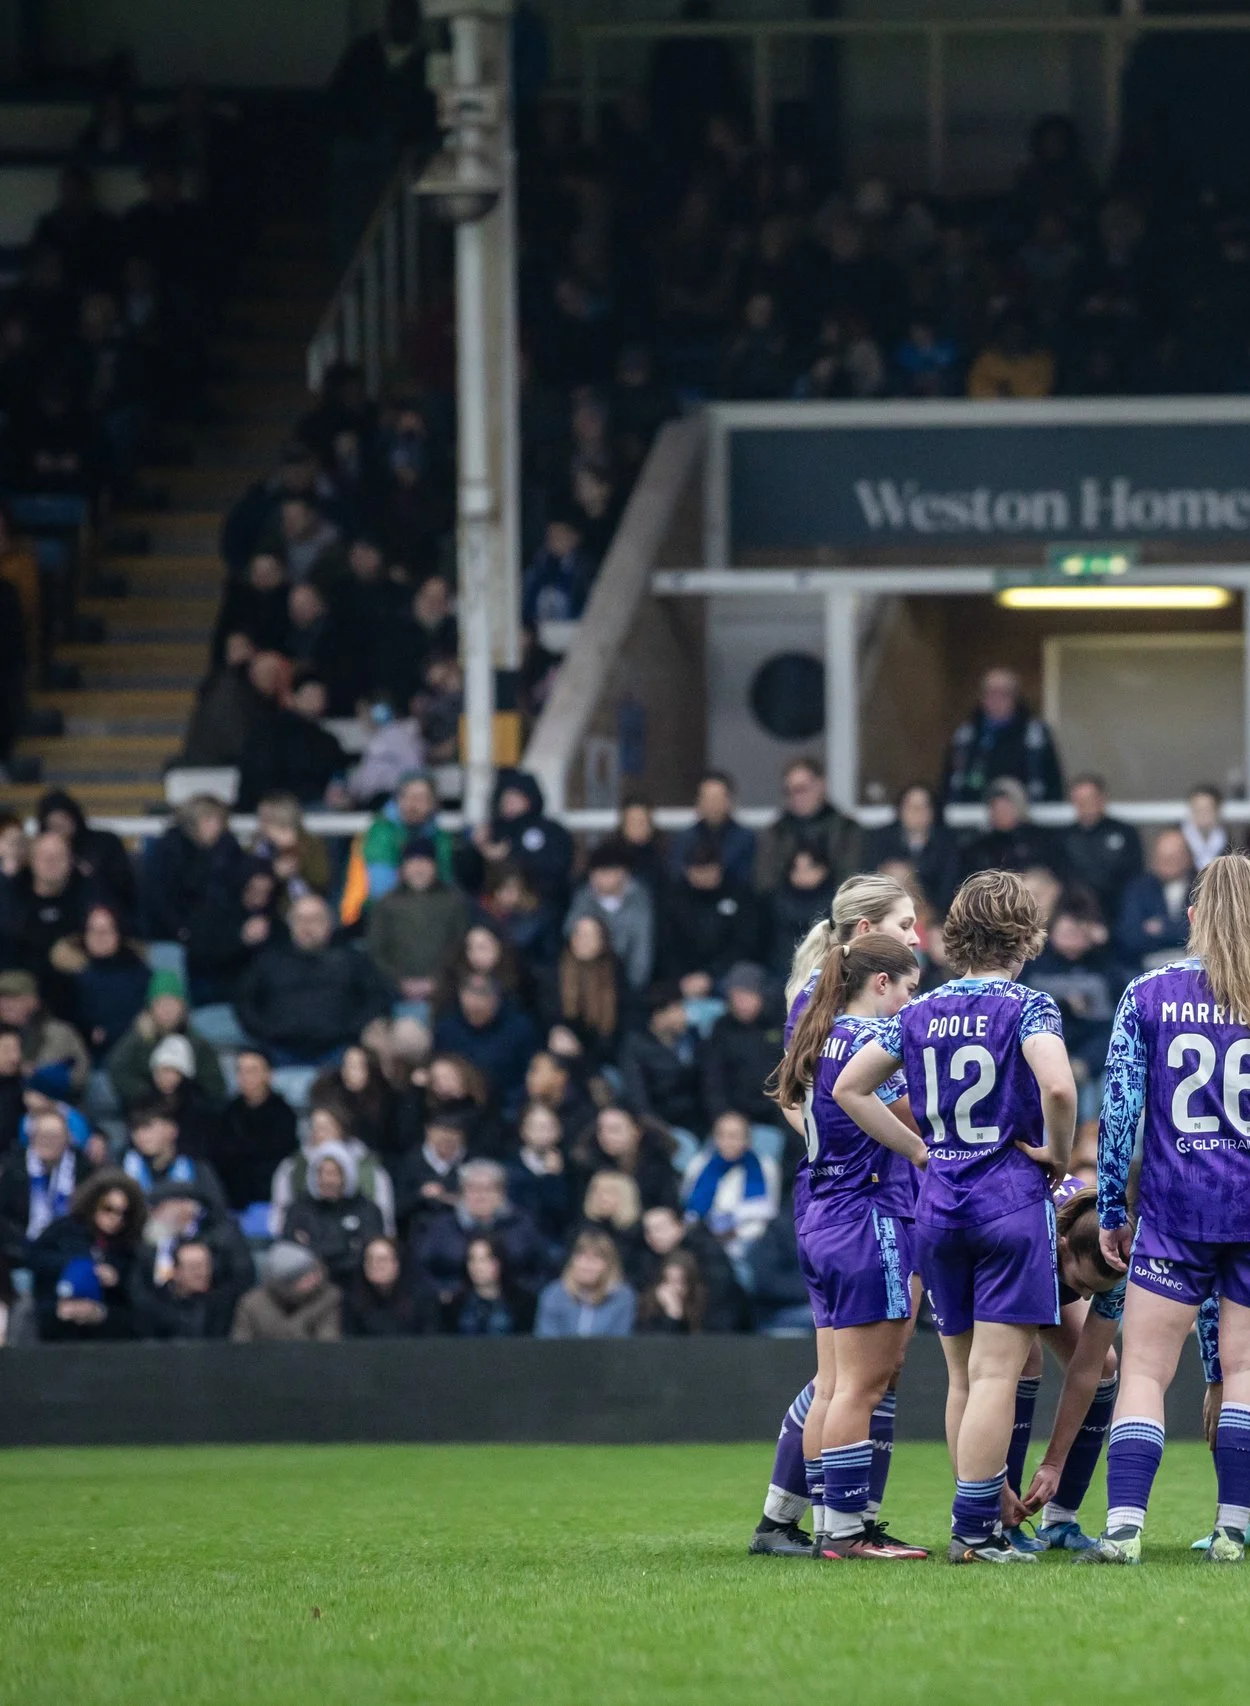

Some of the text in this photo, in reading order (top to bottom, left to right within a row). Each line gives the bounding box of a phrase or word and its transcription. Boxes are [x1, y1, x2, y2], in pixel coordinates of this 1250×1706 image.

[854, 478, 1069, 532] Weston
[927, 1016, 988, 1039] POOLE
[923, 1045, 1000, 1144] 12
